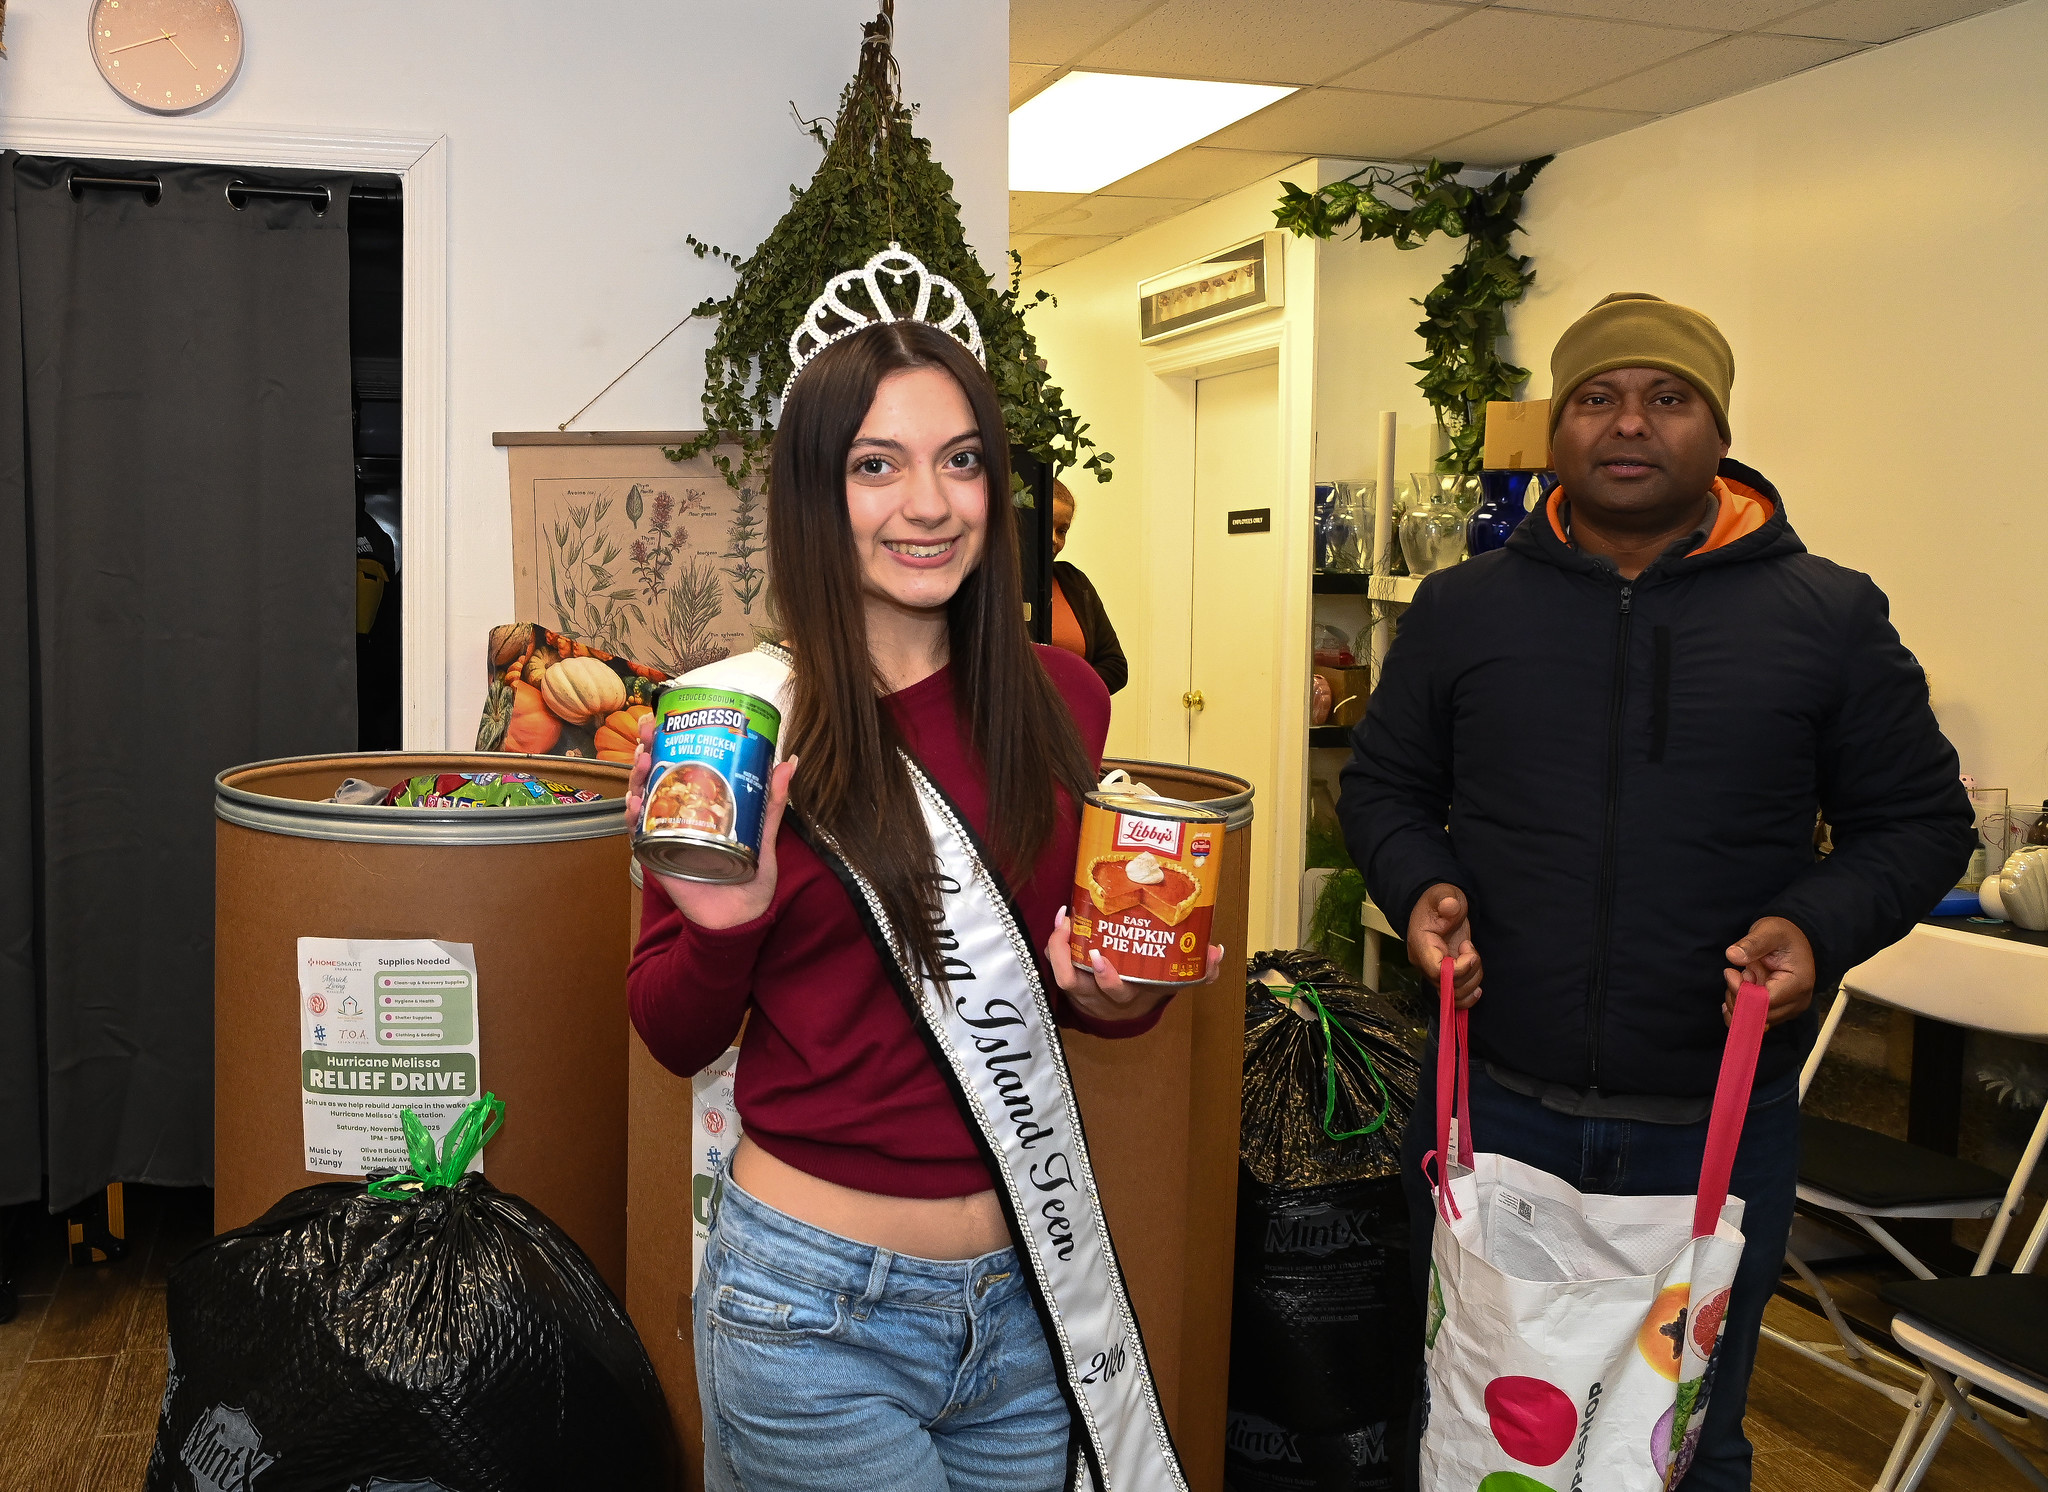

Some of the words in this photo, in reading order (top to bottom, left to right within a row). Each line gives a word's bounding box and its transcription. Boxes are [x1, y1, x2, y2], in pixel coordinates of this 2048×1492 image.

[104, 30, 111, 38] 9
[113, 60, 120, 68] 8
[195, 84, 201, 92] 5
[708, 694, 735, 705] SODIUM
[666, 709, 742, 732] PROGRESSO
[664, 734, 696, 748] SAVORY
[697, 734, 737, 753] CHICKEN
[670, 746, 676, 756] &
[678, 744, 702, 756] WILD
[703, 745, 725, 760] RICE
[1122, 820, 1173, 844] Libby's
[1123, 915, 1151, 927] EASY
[1098, 920, 1175, 945] PUMPKIN
[1102, 935, 1131, 952] PIE
[1132, 942, 1166, 958] MIX
[378, 958, 415, 967] Supplies
[327, 1056, 389, 1068] Hurricane
[392, 1057, 441, 1068] Melissa
[310, 1069, 386, 1090] RELIEF
[391, 1072, 466, 1091] DRIVE
[330, 1110, 364, 1118] Hurricane
[337, 1124, 369, 1132] Saturday,
[956, 996, 1054, 1150] Island
[1030, 1152, 1078, 1262] Teen
[333, 1148, 342, 1157] by
[310, 1157, 318, 1165] Dj
[319, 1158, 342, 1168] Zungy
